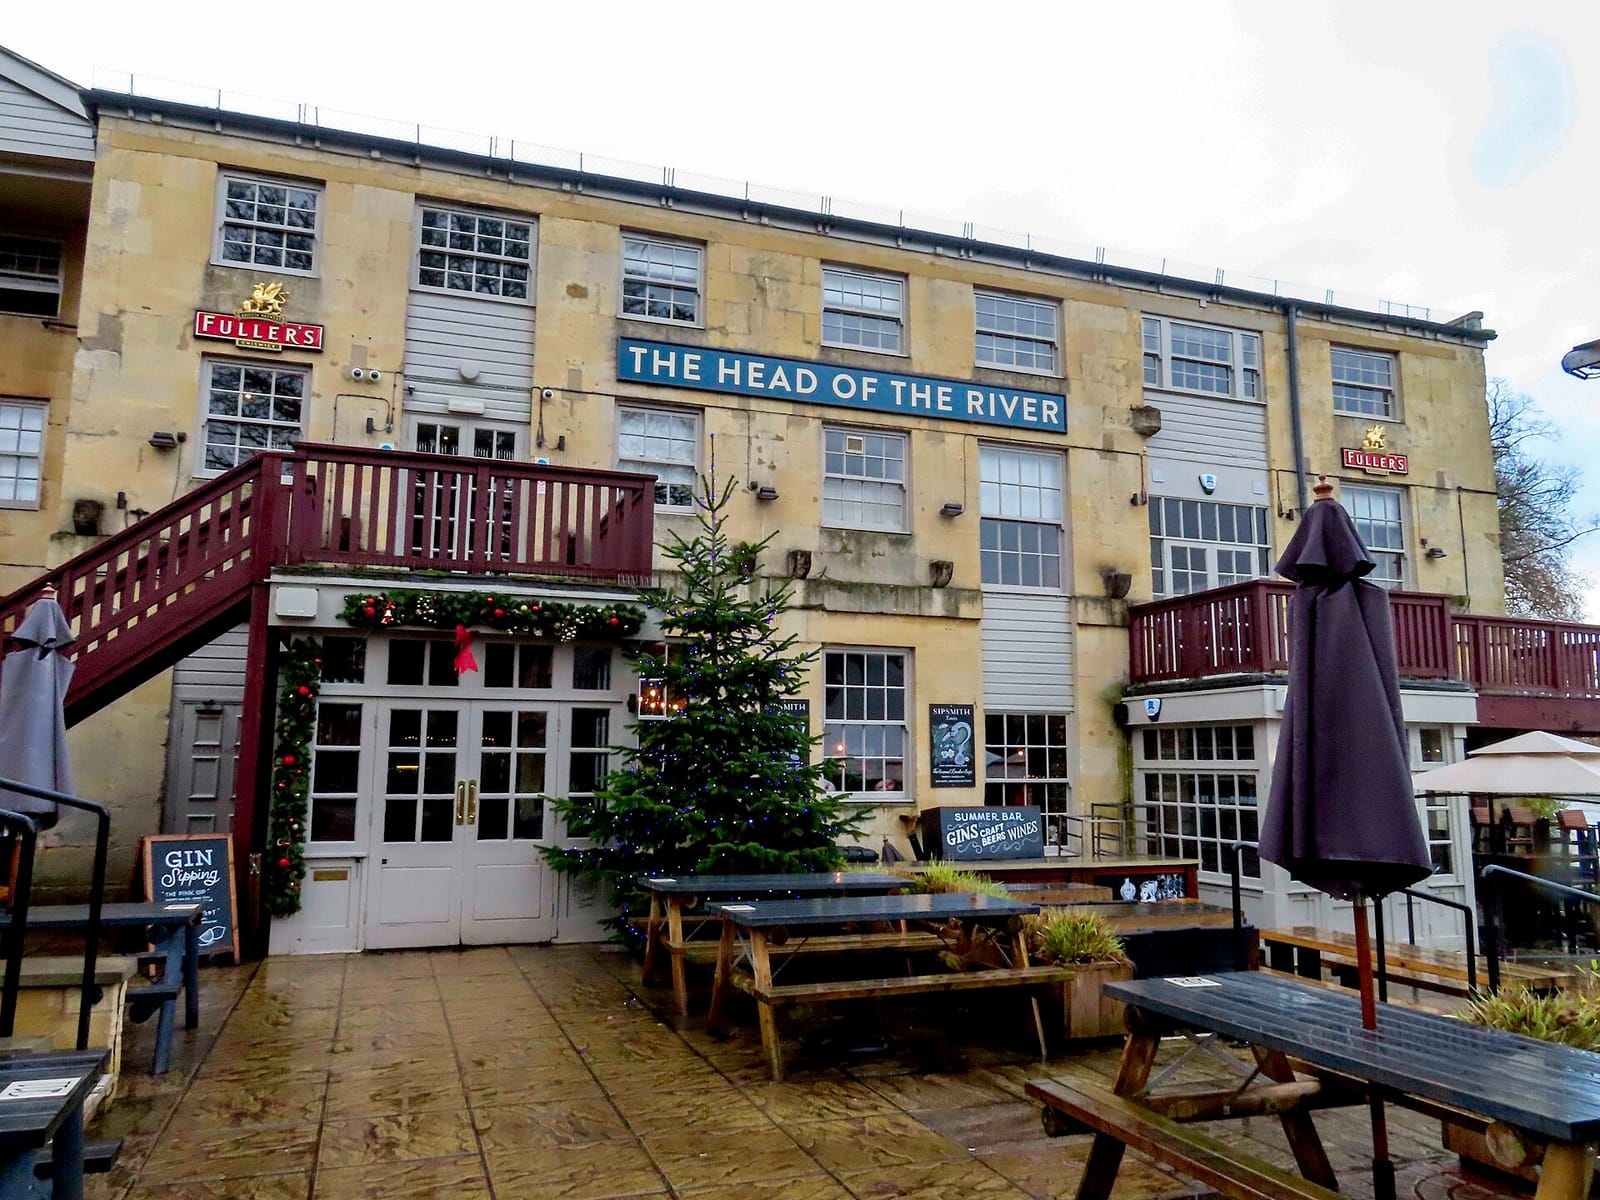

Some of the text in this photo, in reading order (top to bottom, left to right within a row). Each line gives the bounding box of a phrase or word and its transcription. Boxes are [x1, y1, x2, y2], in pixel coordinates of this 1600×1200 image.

[202, 315, 314, 344] FULLER'S
[628, 346, 1059, 425] THE HEAD OF THE RIVER
[1348, 451, 1404, 470] FULLER'S
[954, 812, 1025, 821] SUMMER BAR
[946, 823, 979, 846] GINS
[980, 823, 1004, 838] CRAFT
[981, 831, 1006, 847] BEERS
[1007, 820, 1038, 841] WINES
[165, 849, 214, 868] GIN
[161, 867, 220, 887] Sipping
